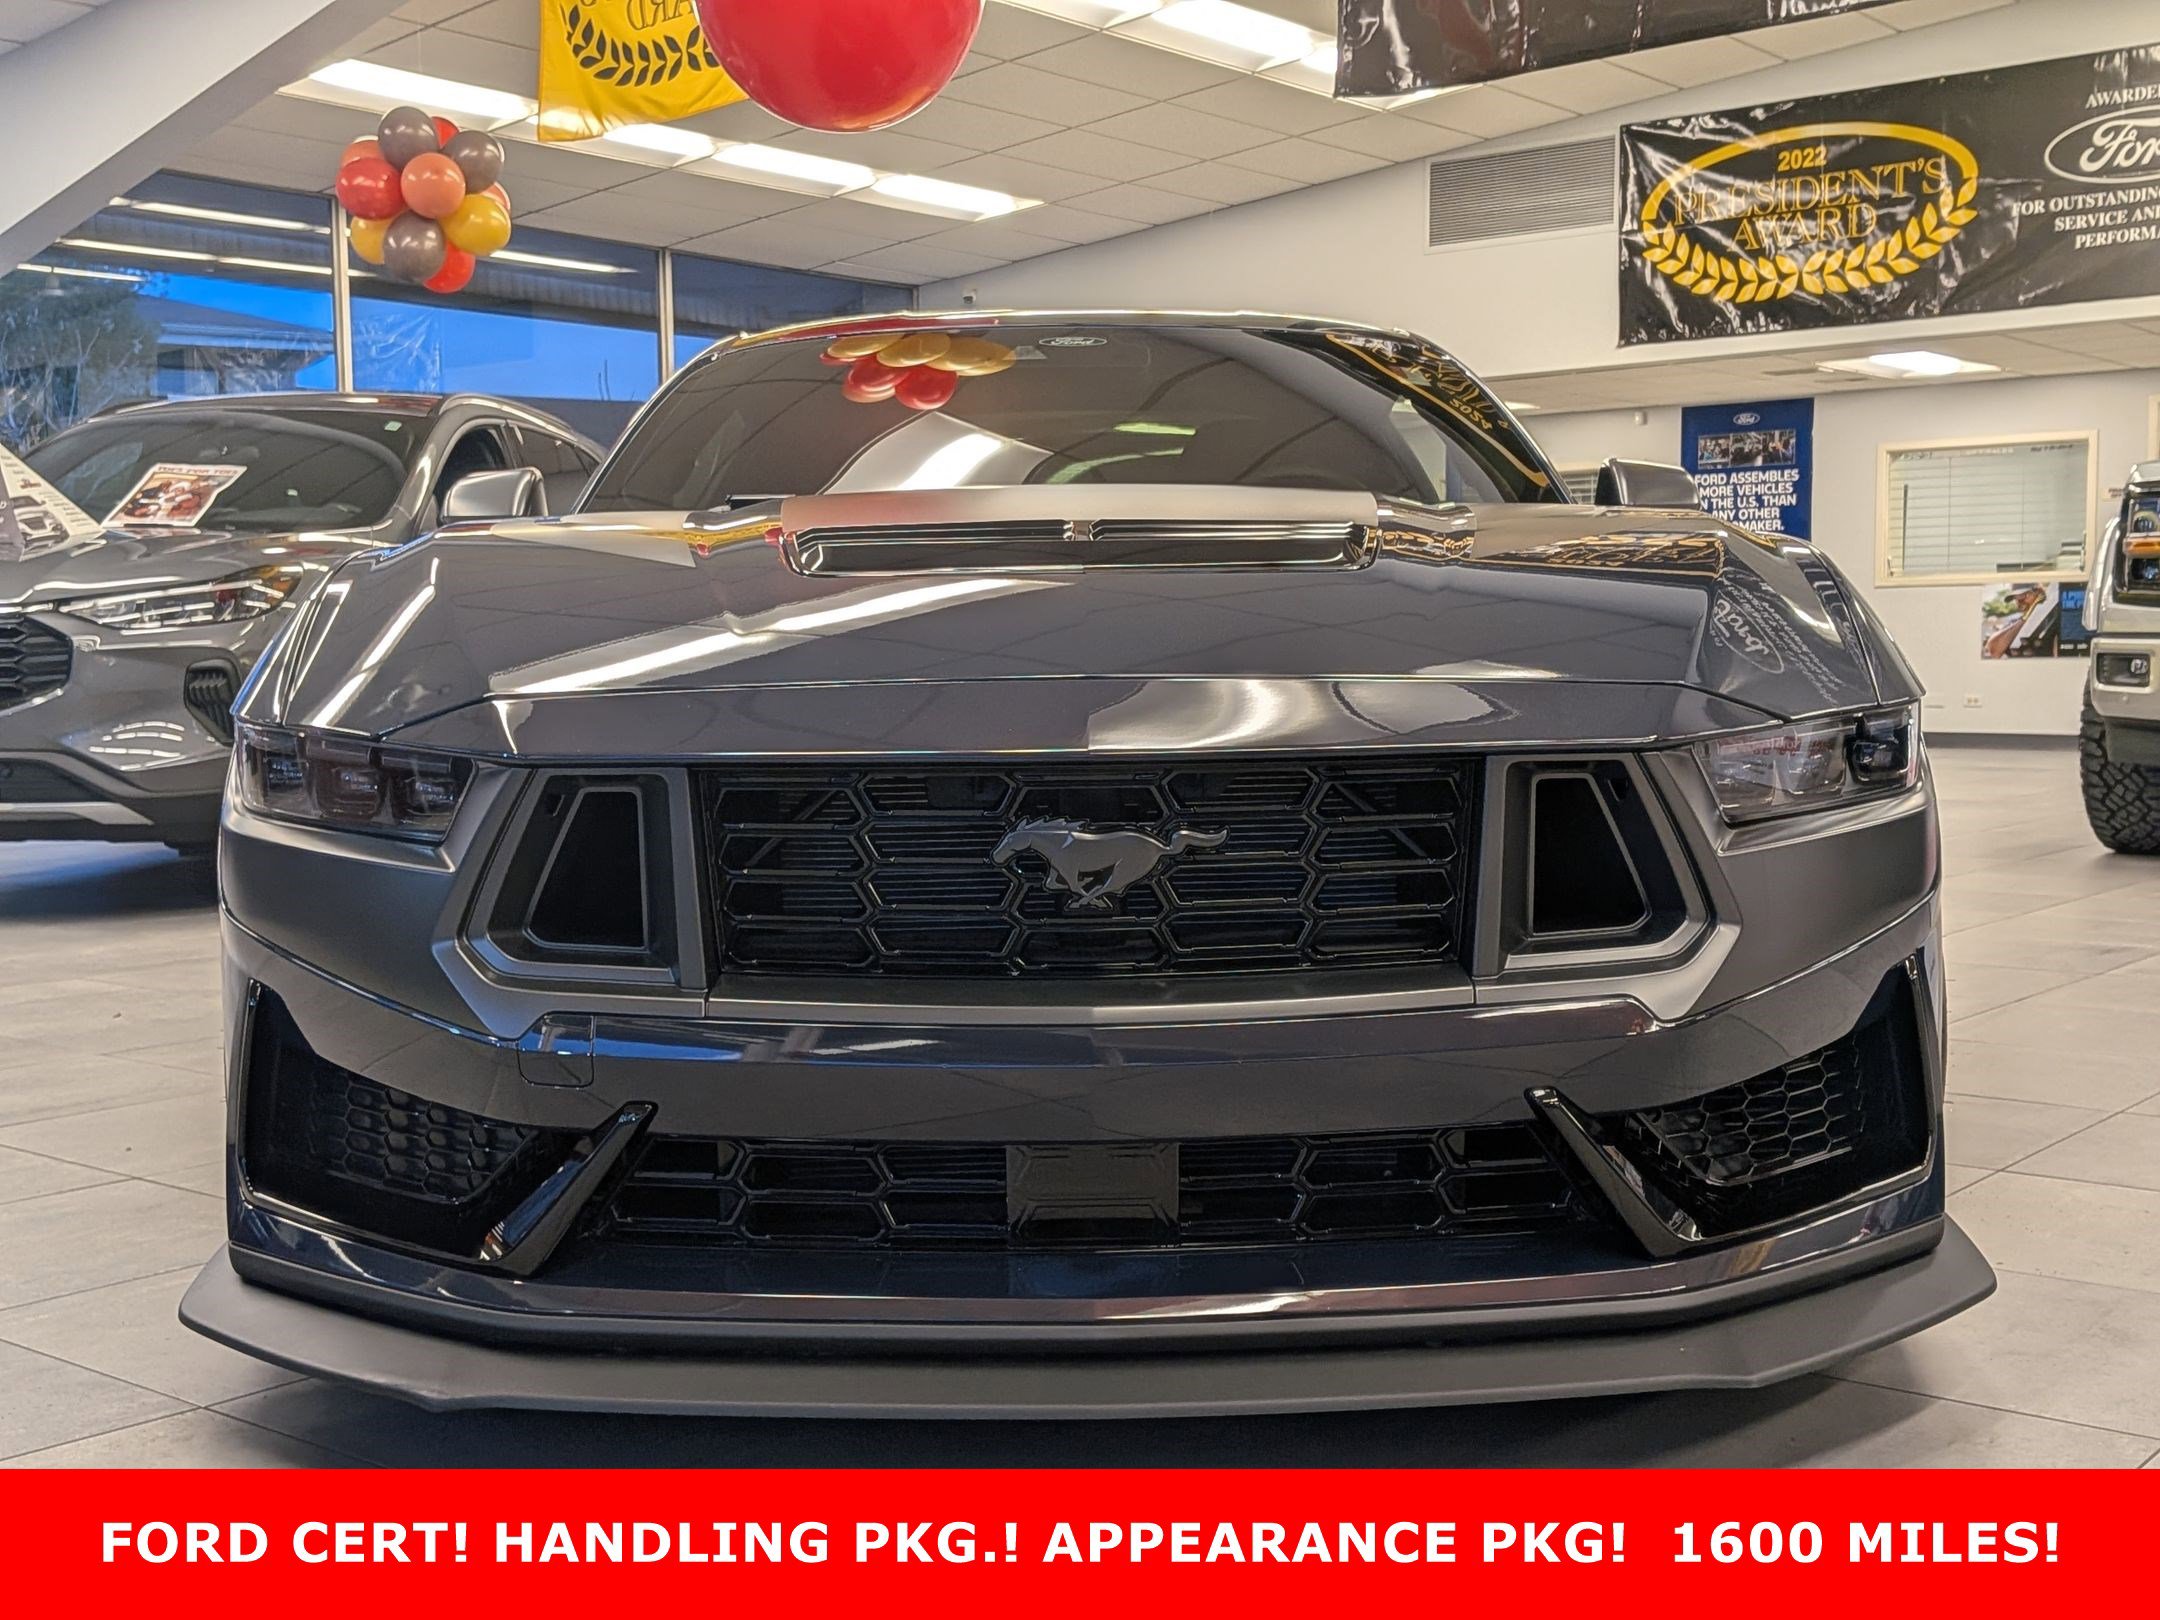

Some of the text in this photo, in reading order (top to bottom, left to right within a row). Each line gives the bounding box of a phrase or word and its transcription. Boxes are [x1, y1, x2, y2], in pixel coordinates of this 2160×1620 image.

[2085, 83, 2160, 109] AWARDE
[1778, 148, 1827, 172] 2022
[1674, 157, 1946, 226] PRESIDENT'S
[2011, 186, 2160, 217] FOR OUTSTANDIN
[1727, 202, 1877, 251] AWARD
[2054, 209, 2128, 232] SERVICE
[1049, 336, 1098, 347] Ford
[1694, 468, 1800, 486] FORD ASSEMBLES
[1700, 482, 1794, 498] MORE VEHICLES
[1700, 494, 1797, 510] N THE U.S. THAN
[1711, 507, 1780, 521] ANY OTHER
